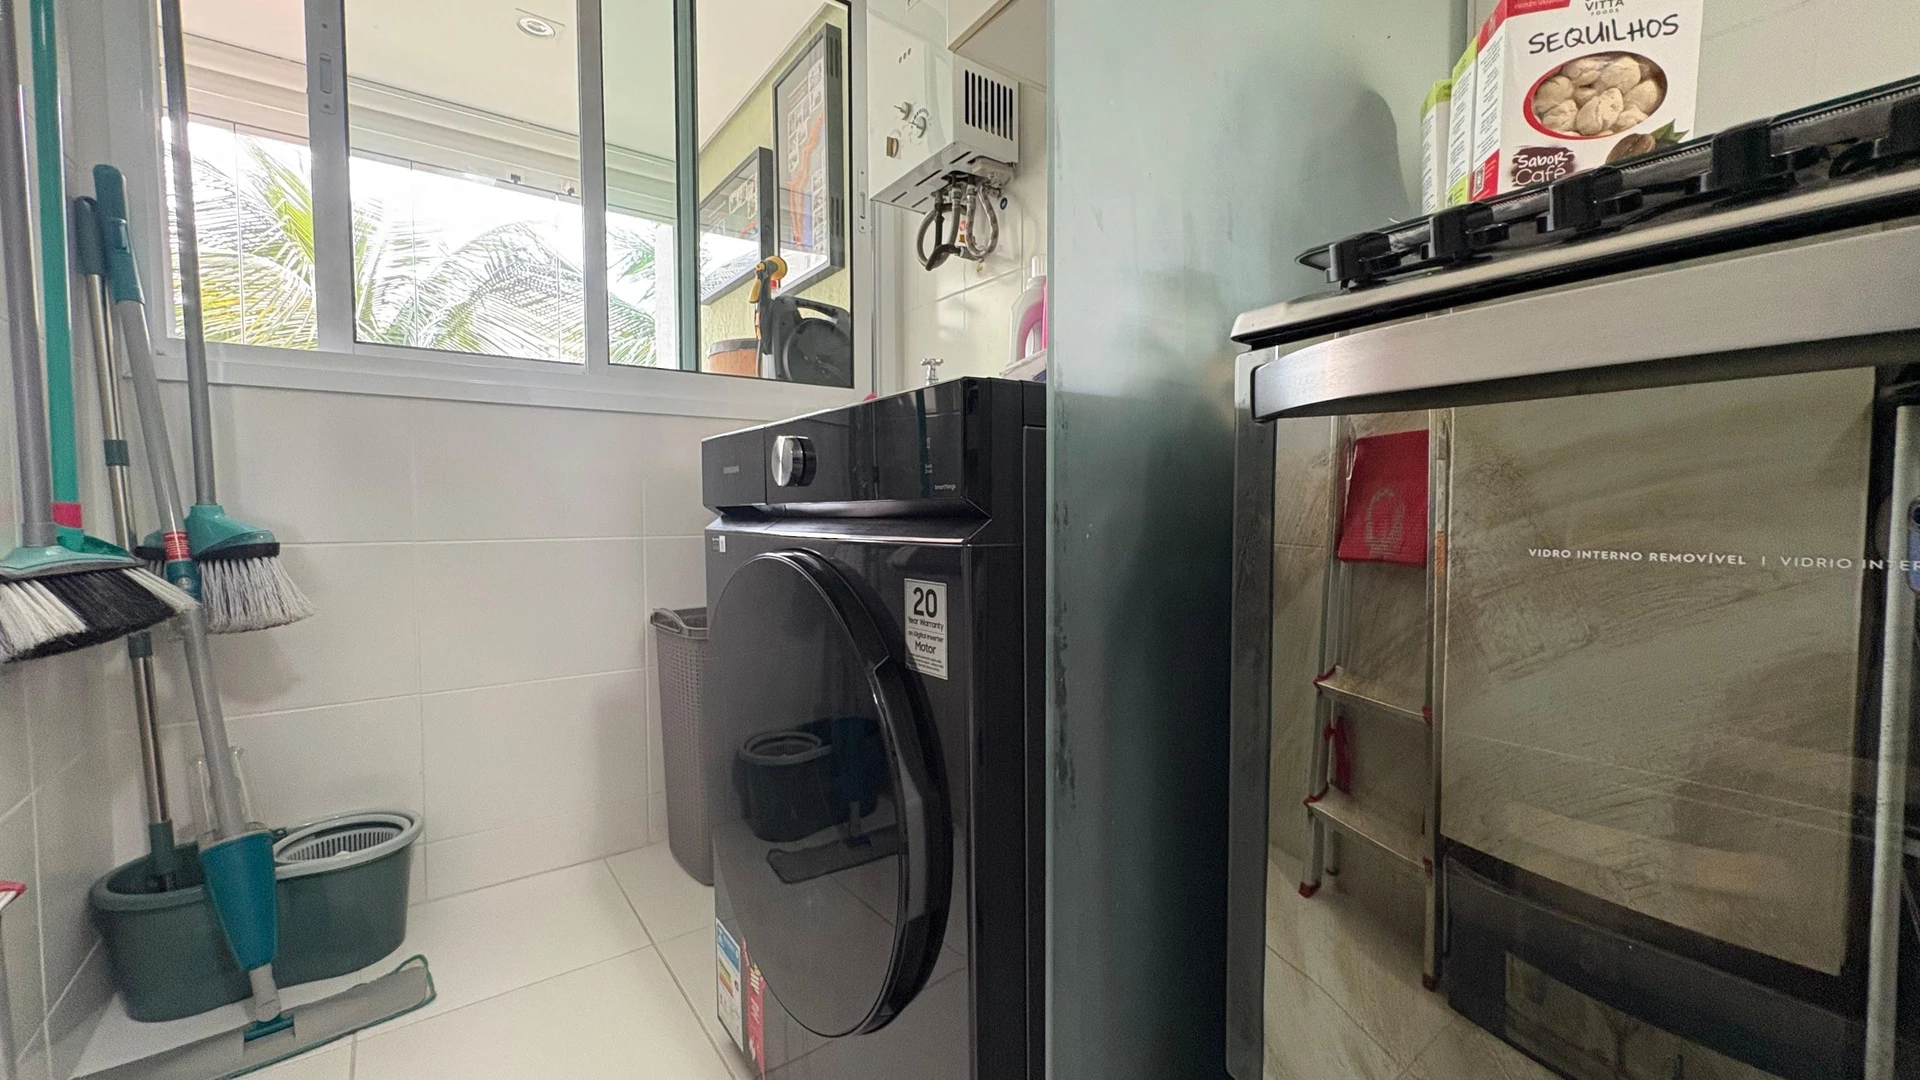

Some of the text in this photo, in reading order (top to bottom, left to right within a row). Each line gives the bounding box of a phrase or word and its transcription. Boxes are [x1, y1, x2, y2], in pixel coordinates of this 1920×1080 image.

[1585, 0, 1624, 11] VITTA
[1590, 8, 1620, 16] FOODS
[1528, 13, 1679, 54] SEQUILHOS
[1515, 162, 1567, 185] Café
[1528, 548, 1572, 559] VIDRO
[1576, 550, 1643, 562] INTERNO
[1649, 552, 1747, 566] REMOVÍVEL
[1781, 557, 1853, 570] VIDRIO
[913, 587, 937, 617] 20
[908, 616, 944, 631] Year Warranty
[915, 640, 936, 654] Motor
